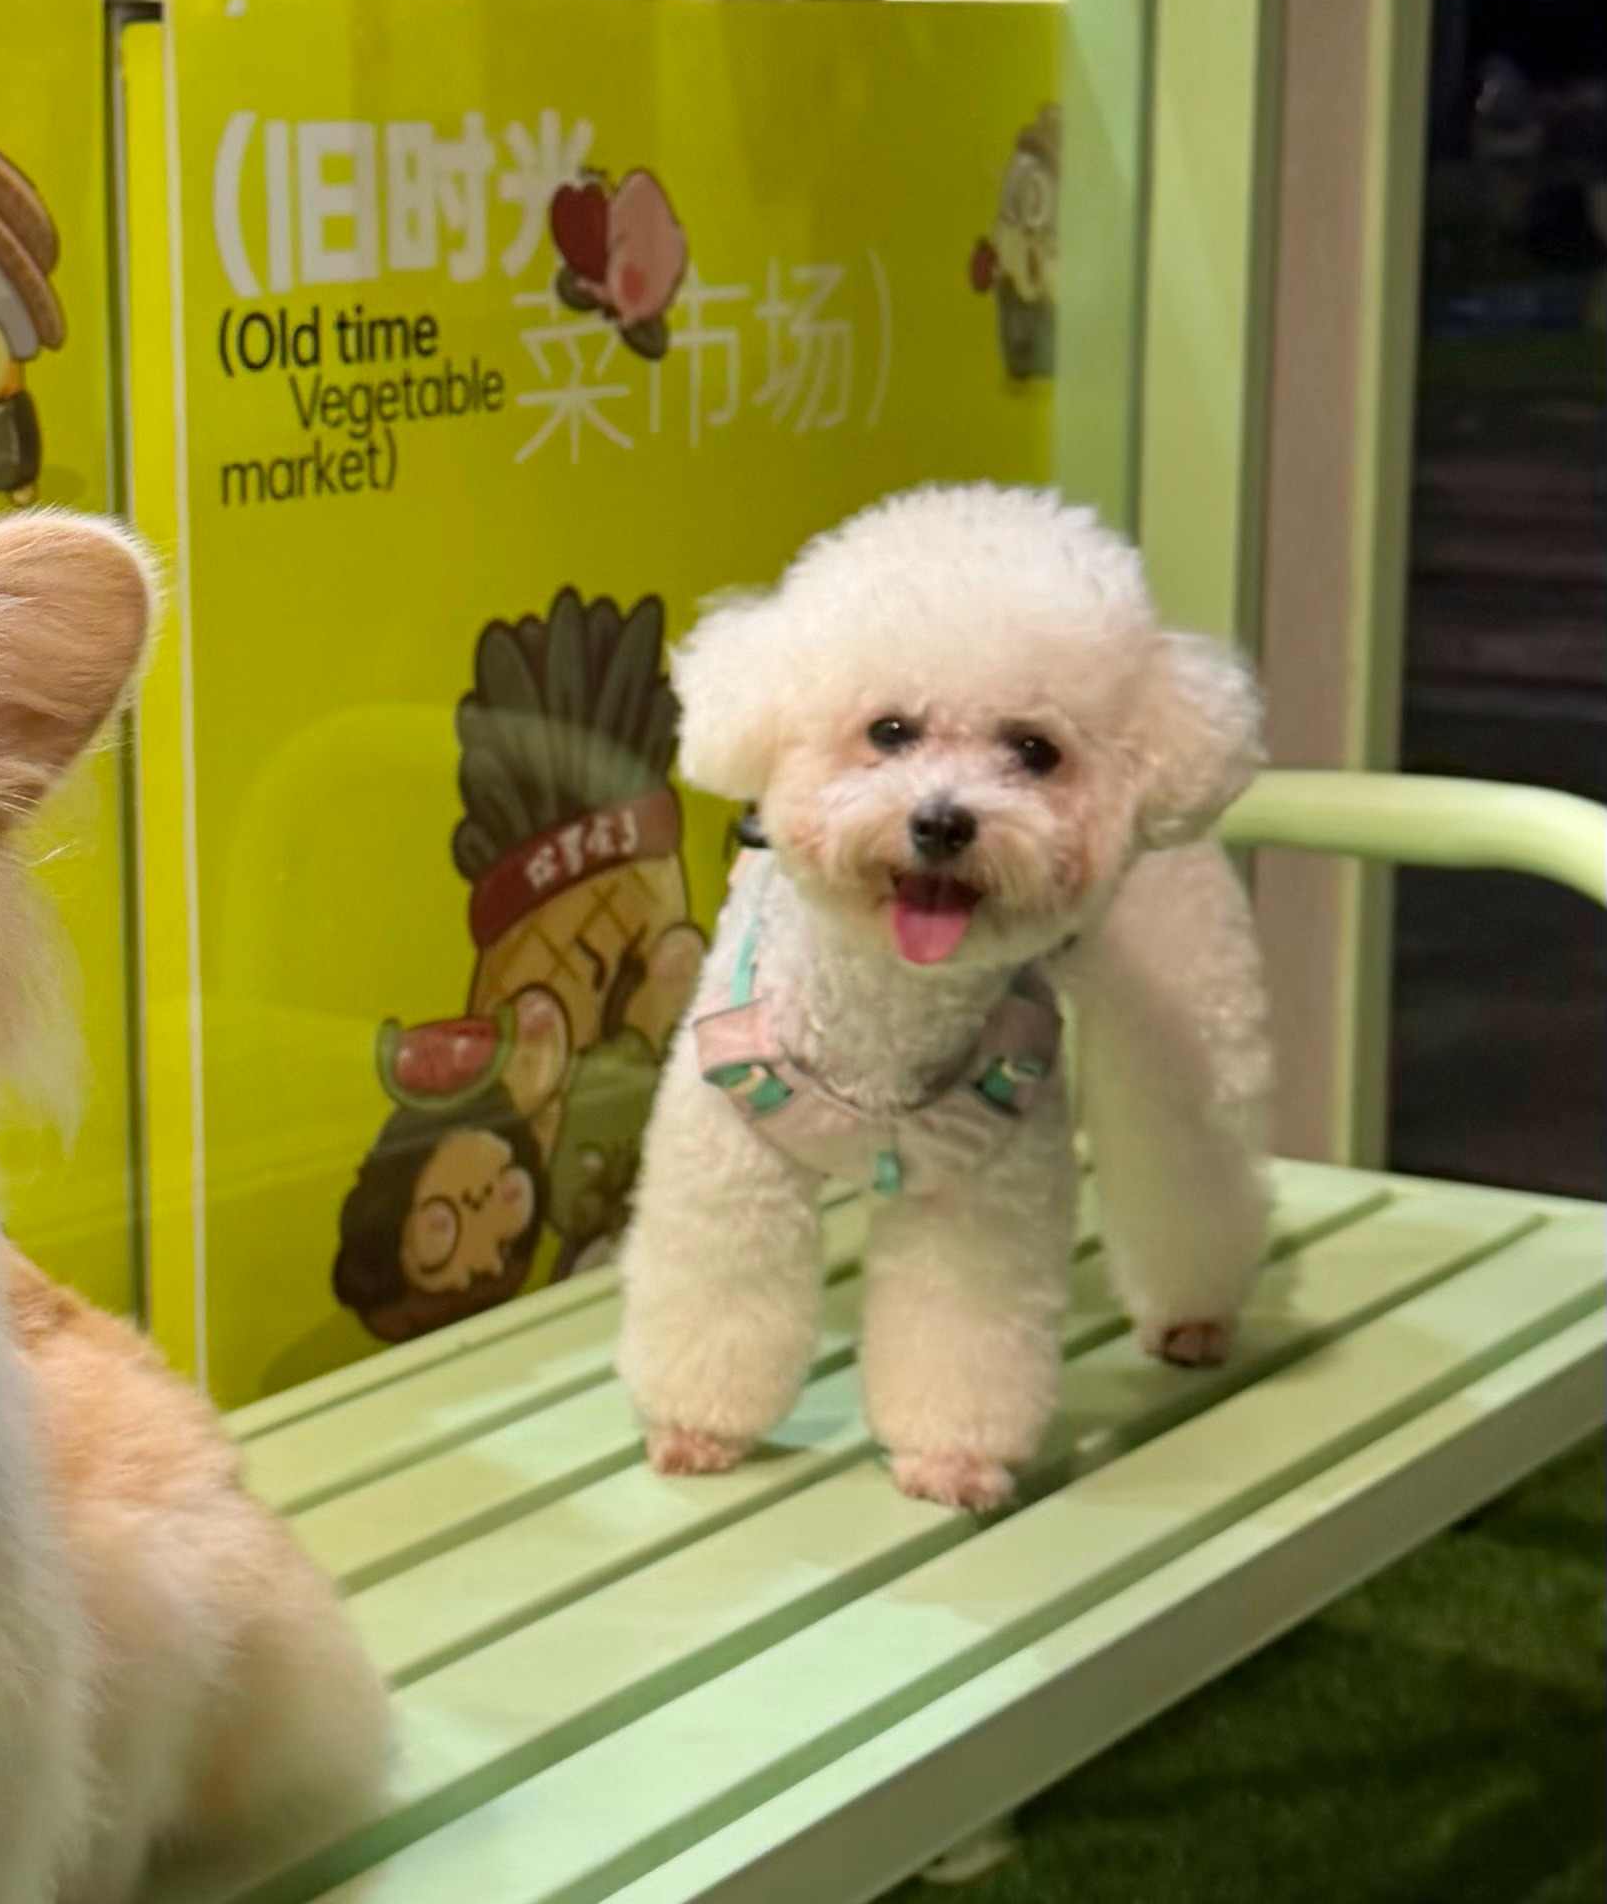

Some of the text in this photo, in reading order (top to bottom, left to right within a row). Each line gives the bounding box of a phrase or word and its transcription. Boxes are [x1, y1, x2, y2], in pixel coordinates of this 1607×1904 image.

[219, 303, 440, 376] (Old time
[288, 358, 506, 441] Vegetable
[219, 434, 398, 507] market)
